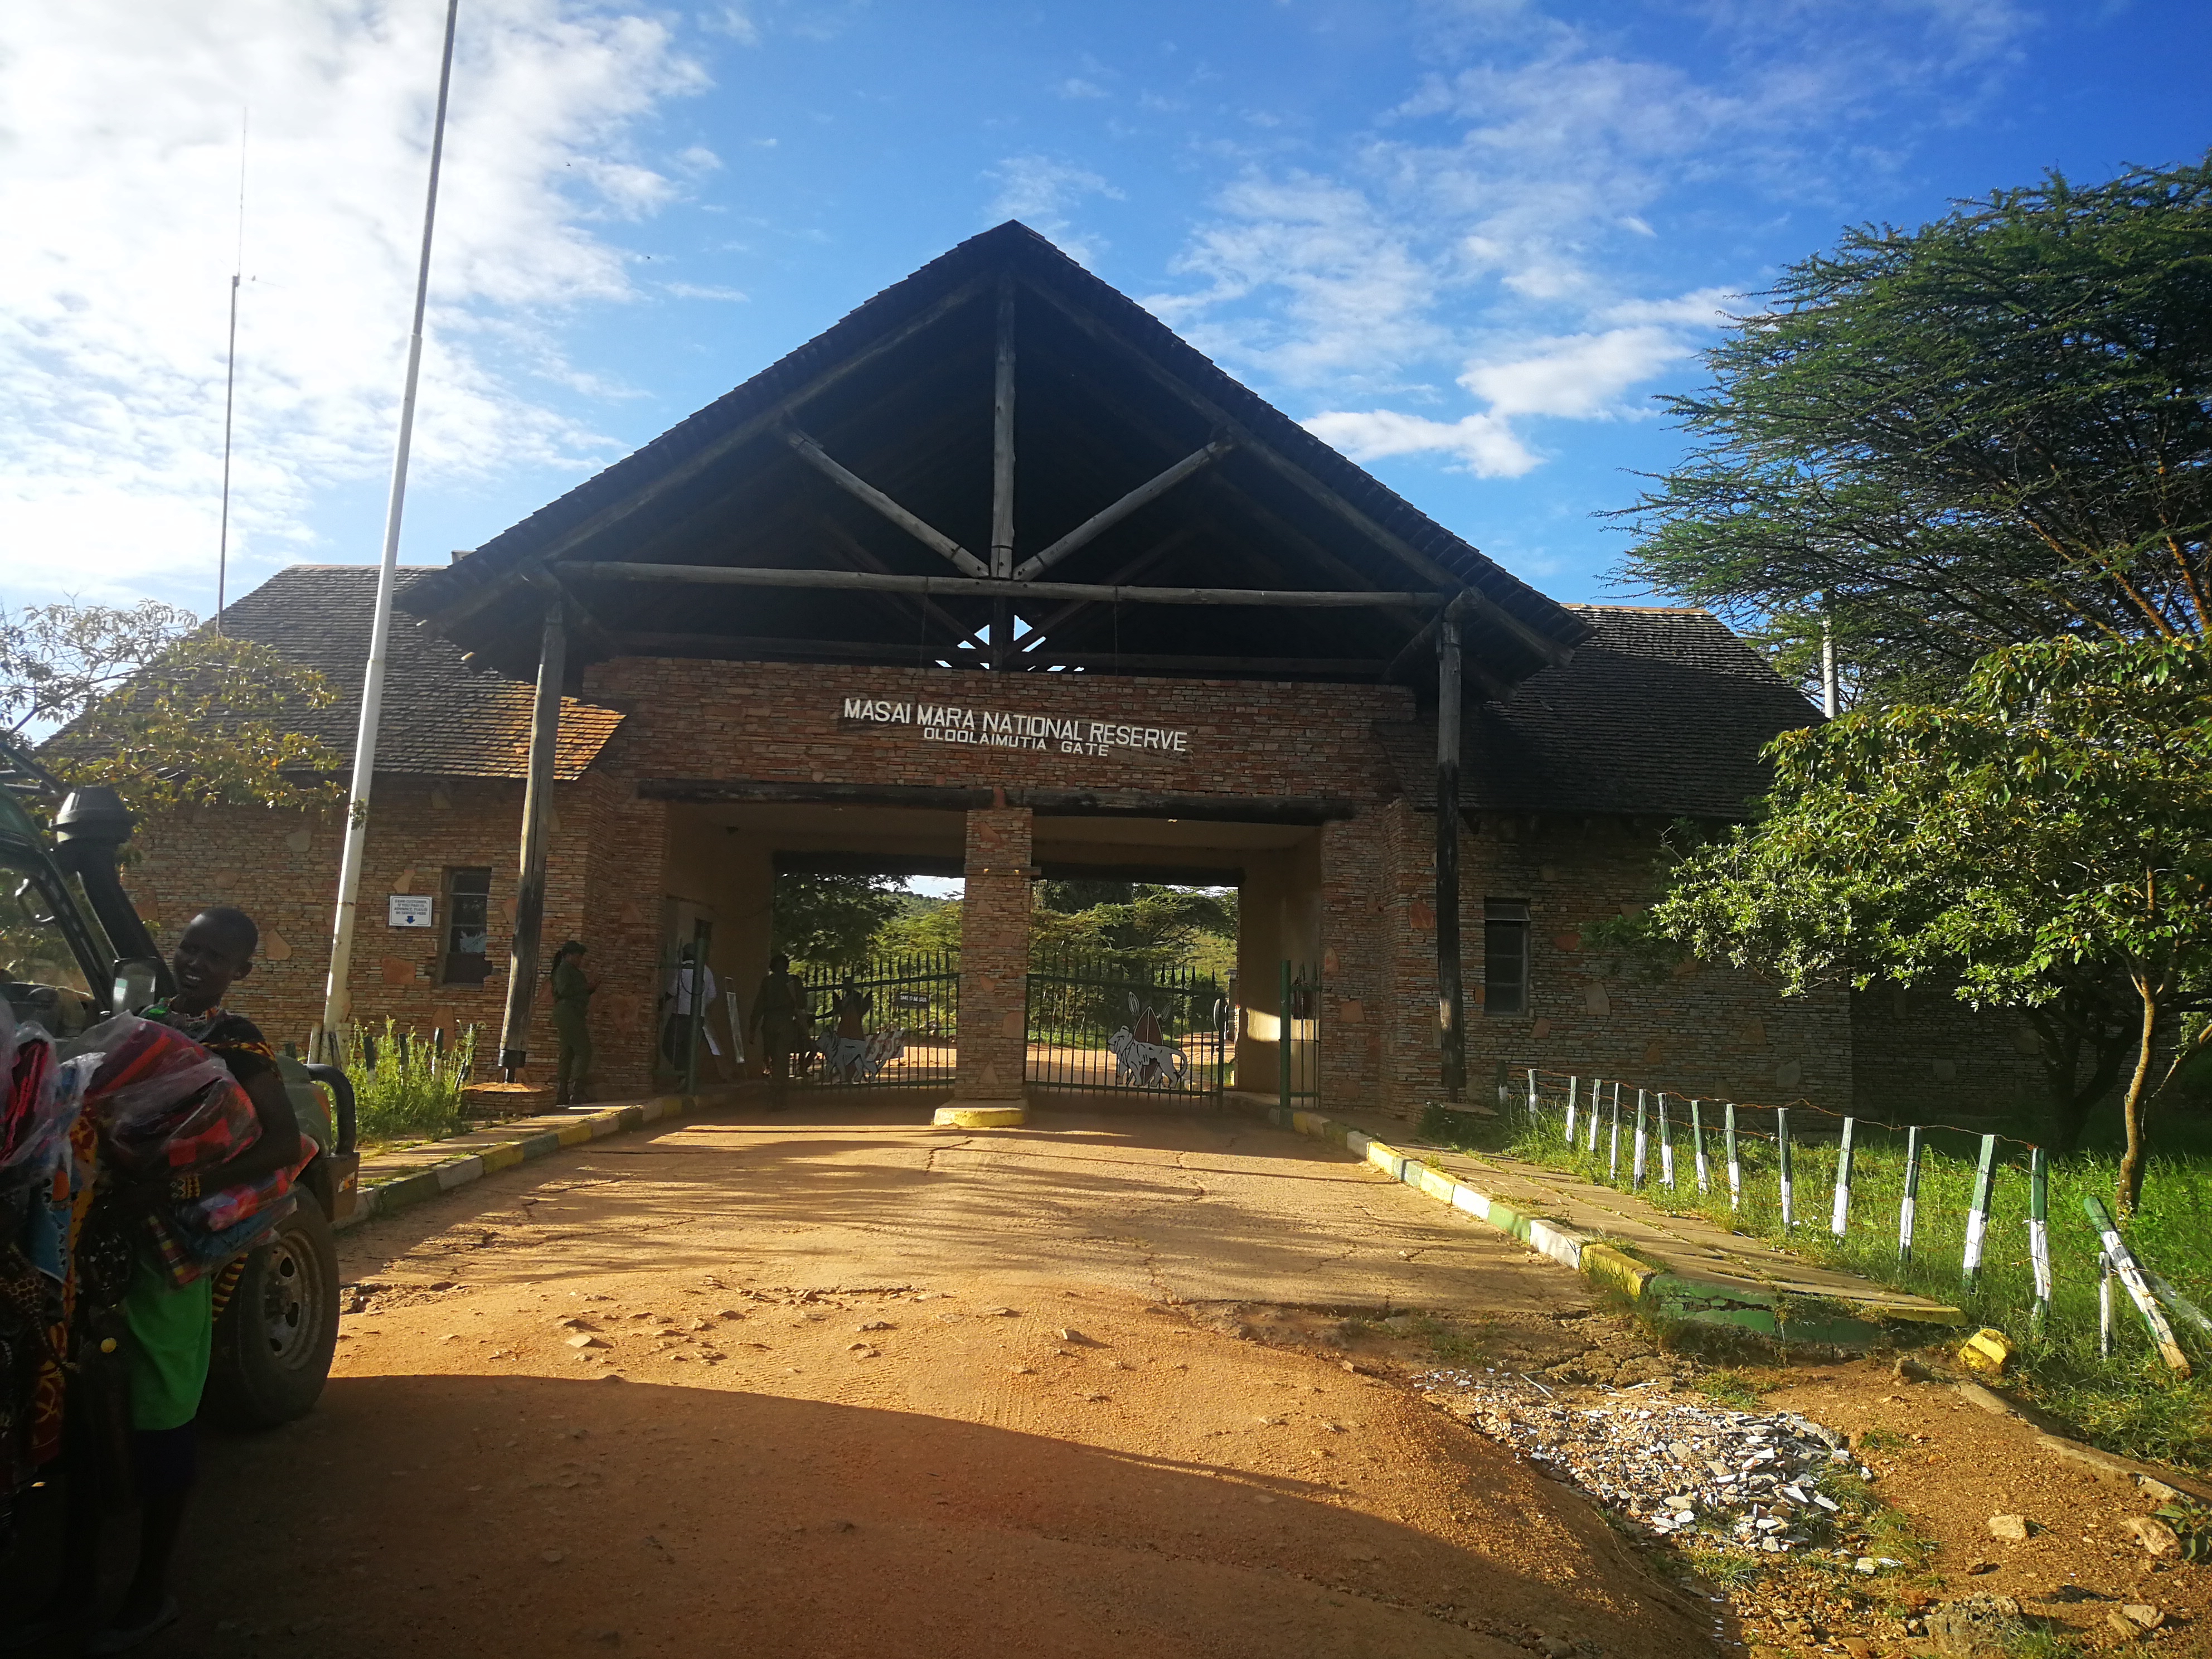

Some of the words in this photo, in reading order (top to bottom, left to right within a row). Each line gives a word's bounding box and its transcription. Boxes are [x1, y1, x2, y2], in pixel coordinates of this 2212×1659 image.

[843, 698, 911, 724] MASAI
[917, 704, 975, 730] MARA
[983, 711, 1083, 741] NATIONAL
[1089, 722, 1188, 752] RESERVE
[923, 727, 1047, 750] OLOOLAIMUTIA
[1061, 740, 1109, 757] GATE
